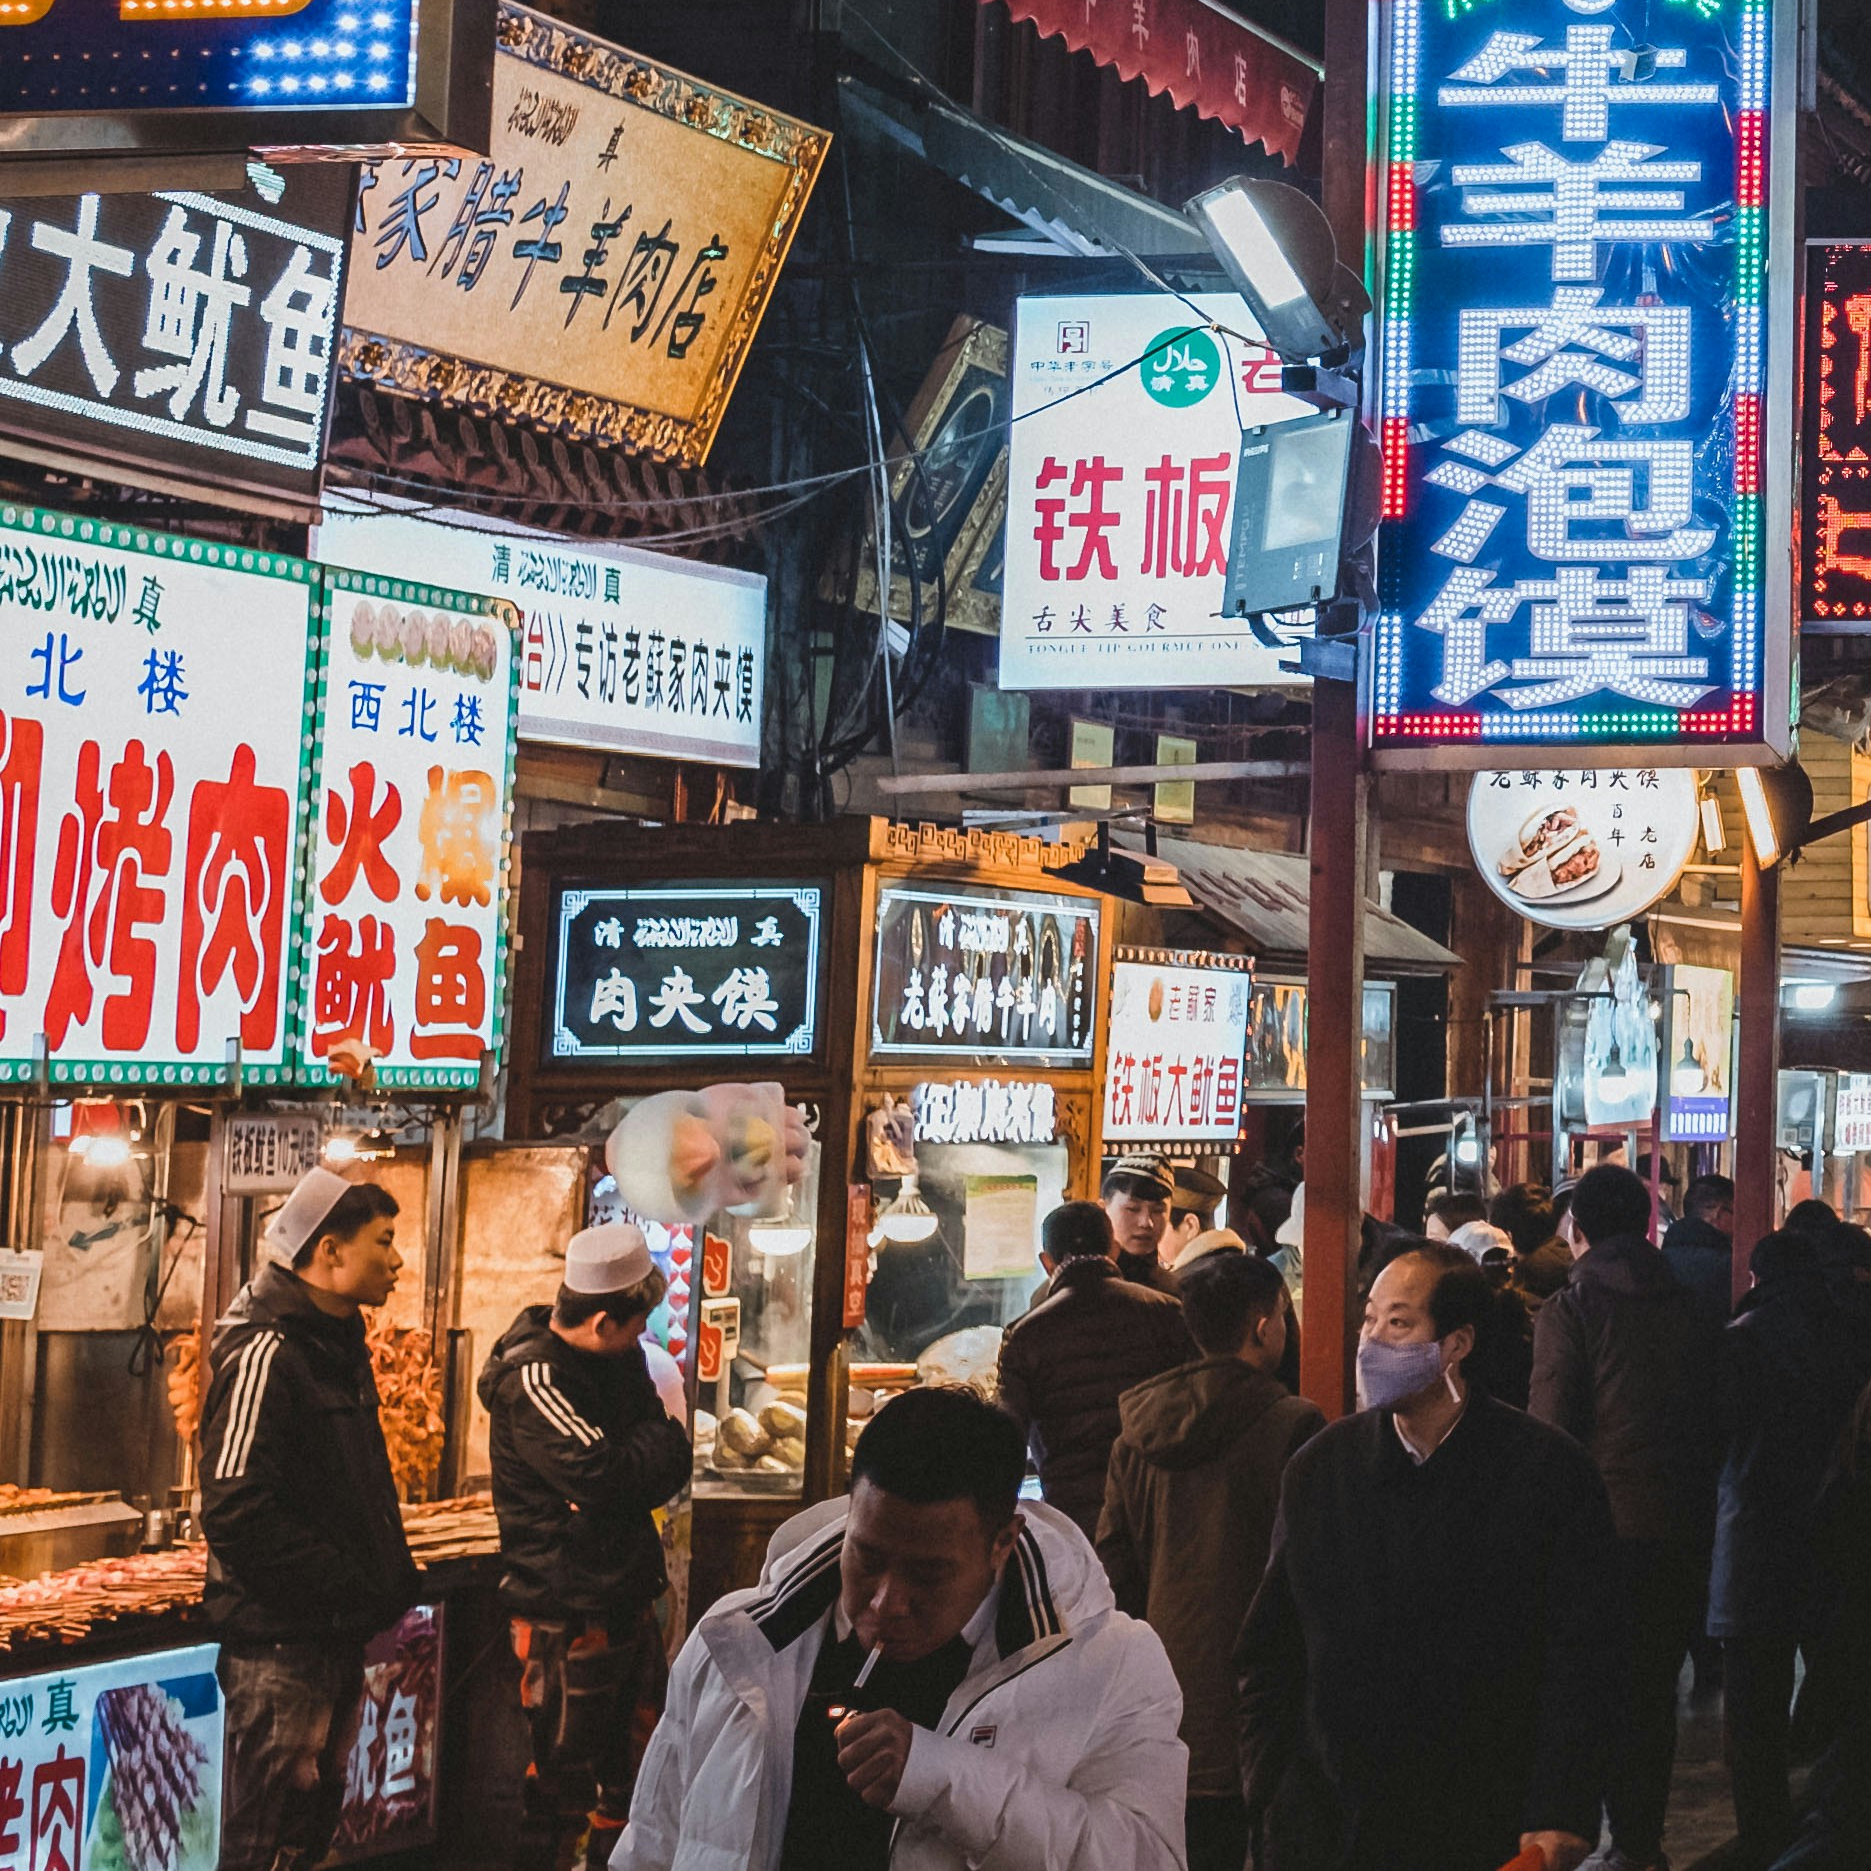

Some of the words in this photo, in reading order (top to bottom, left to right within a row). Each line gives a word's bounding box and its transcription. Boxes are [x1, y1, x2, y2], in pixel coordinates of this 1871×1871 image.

[354, 160, 732, 361] 家腊牛羊肉店
[0, 192, 337, 448] 大鱿鱼
[1422, 23, 1720, 710] 牛羊肉泡馍
[1033, 451, 1232, 582] 铁板
[131, 575, 166, 635] 真
[492, 543, 512, 585] 清
[603, 565, 622, 606] 真
[1031, 602, 1168, 633] 舌尖美食
[25, 630, 191, 717] 北楼
[518, 609, 755, 724] 台》专访老蘇家肉夹馍
[348, 679, 487, 747] 西北楼
[311, 913, 488, 1061] 鱿鱼
[589, 965, 780, 1034] 肉夹馍
[1111, 1050, 1240, 1126] 铁板大鱿鱼
[41, 1677, 80, 1734] 真
